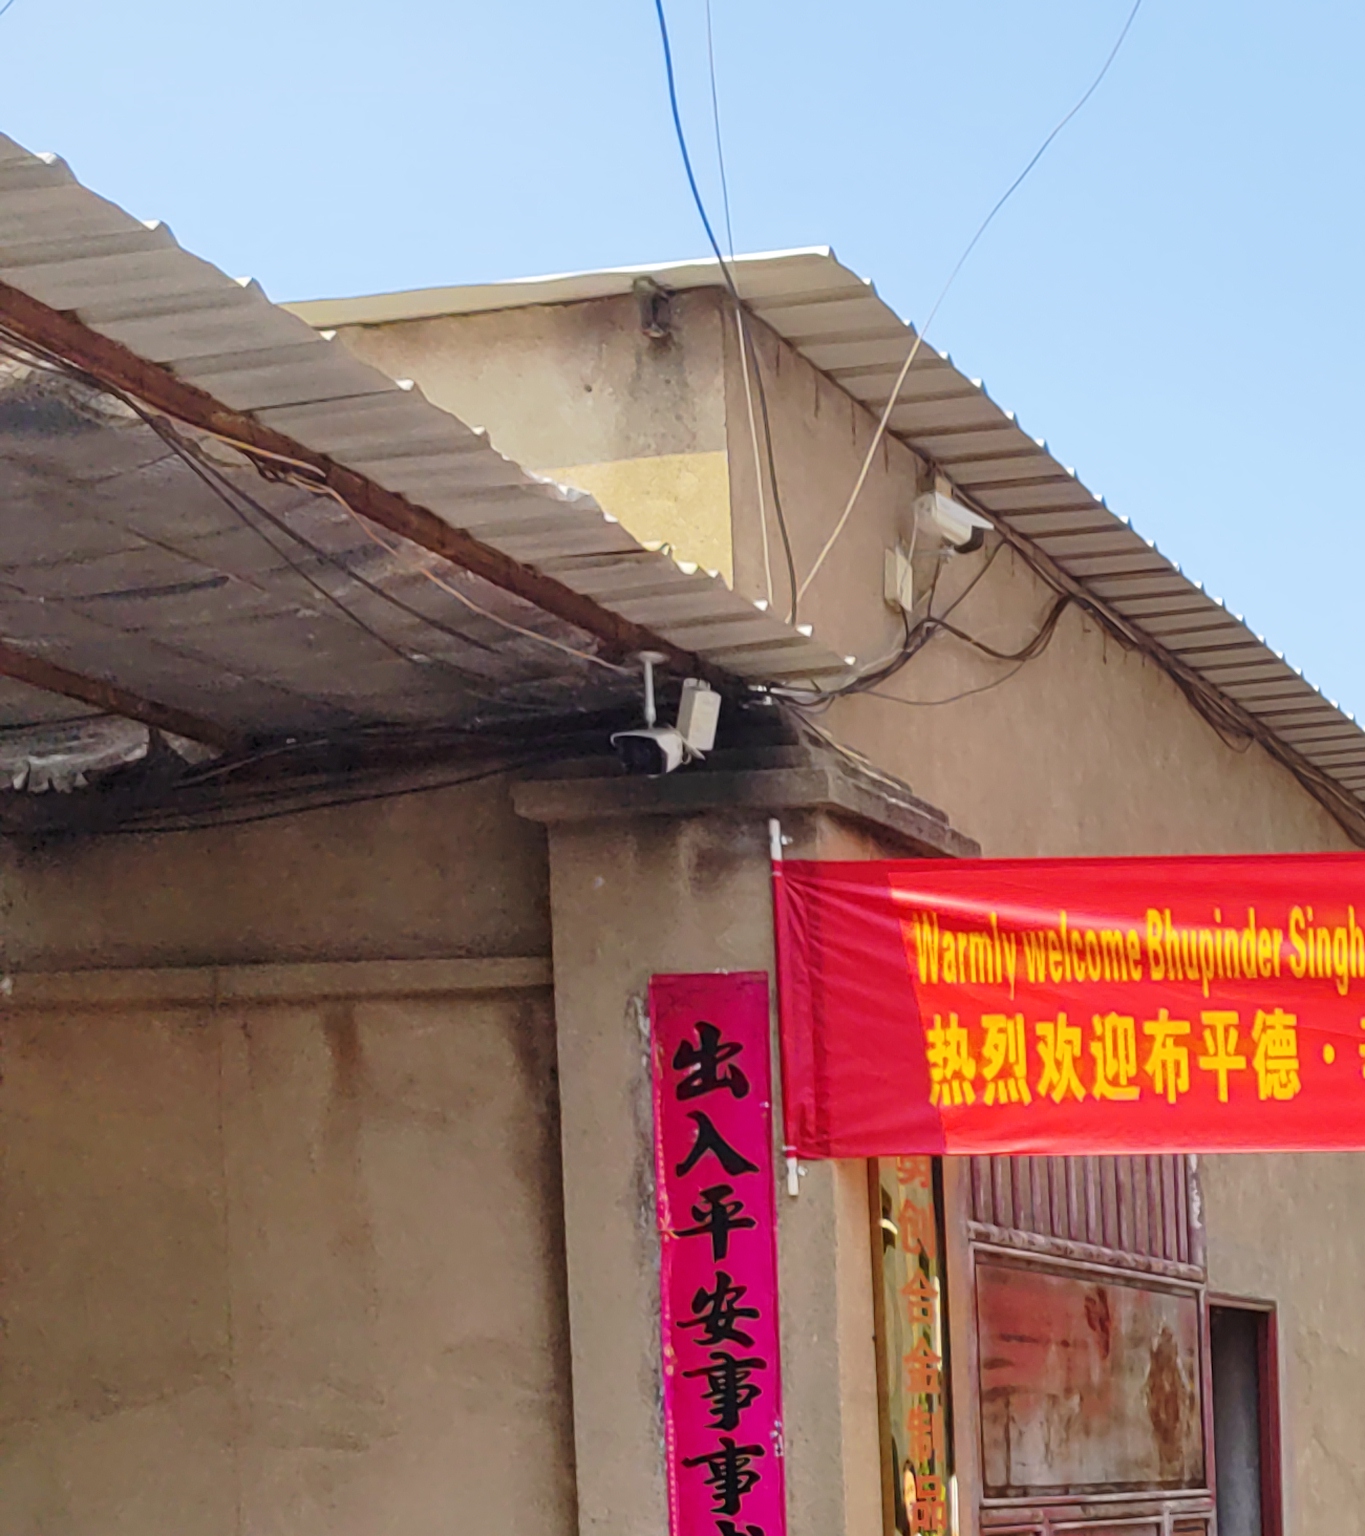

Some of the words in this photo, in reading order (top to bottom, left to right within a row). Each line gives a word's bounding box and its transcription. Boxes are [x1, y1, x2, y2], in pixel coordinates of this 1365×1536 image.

[912, 911, 1017, 1000] Warmly
[1025, 910, 1142, 983] welcome
[1144, 907, 1283, 998] Bhupinder
[1288, 905, 1365, 996] Singh
